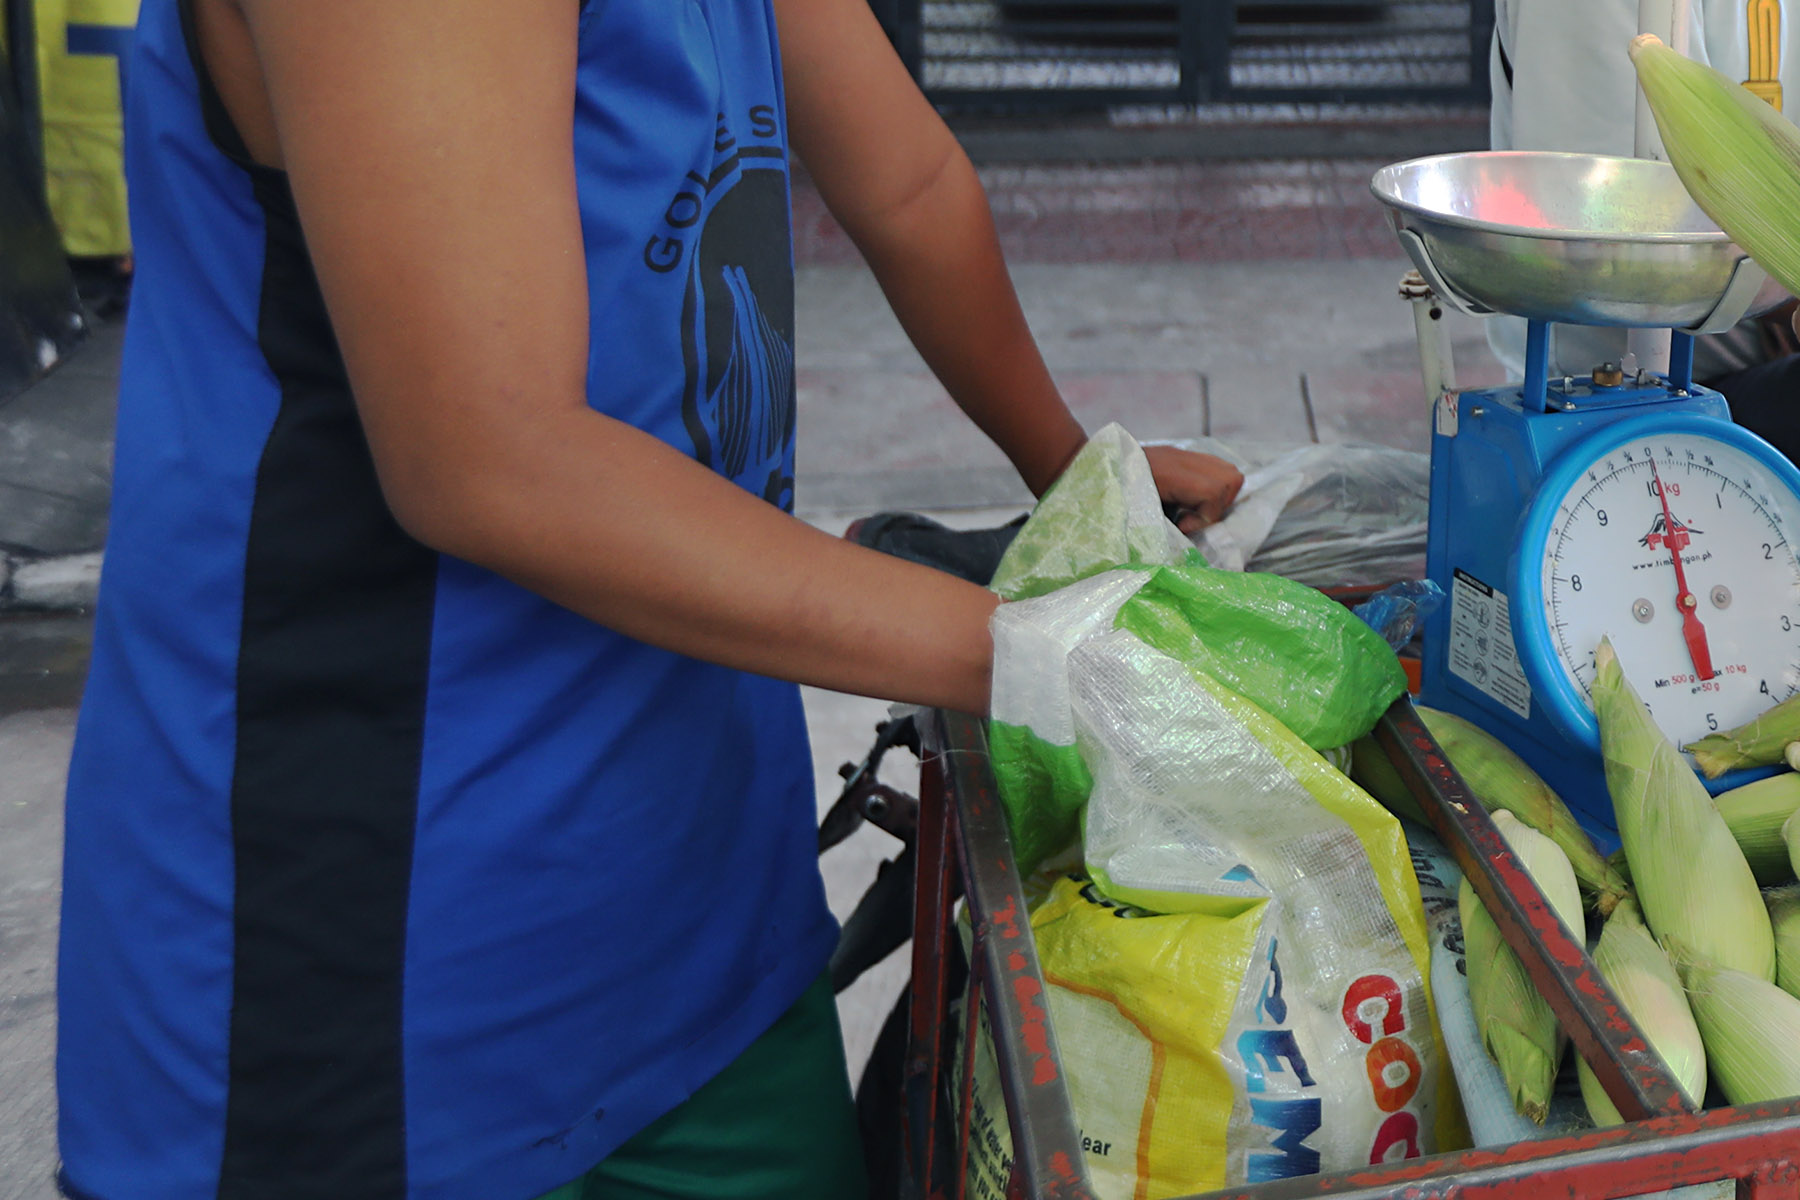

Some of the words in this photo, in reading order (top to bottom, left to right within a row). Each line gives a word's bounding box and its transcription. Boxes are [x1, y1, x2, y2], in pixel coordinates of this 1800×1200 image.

[1646, 479, 1662, 497] 10
[1664, 481, 1681, 496] kg
[1716, 493, 1723, 509] 1
[1597, 509, 1608, 526] 9
[1632, 550, 1713, 570] www.timbngan.ph
[1762, 543, 1773, 560] 2
[1571, 573, 1582, 592] 8
[1781, 615, 1791, 632] 3
[1655, 679, 1670, 688] Min
[1671, 674, 1687, 685] 500
[1725, 665, 1735, 674] 10
[1737, 664, 1747, 673] kg
[1760, 679, 1769, 696] 4
[1706, 713, 1718, 731] 5
